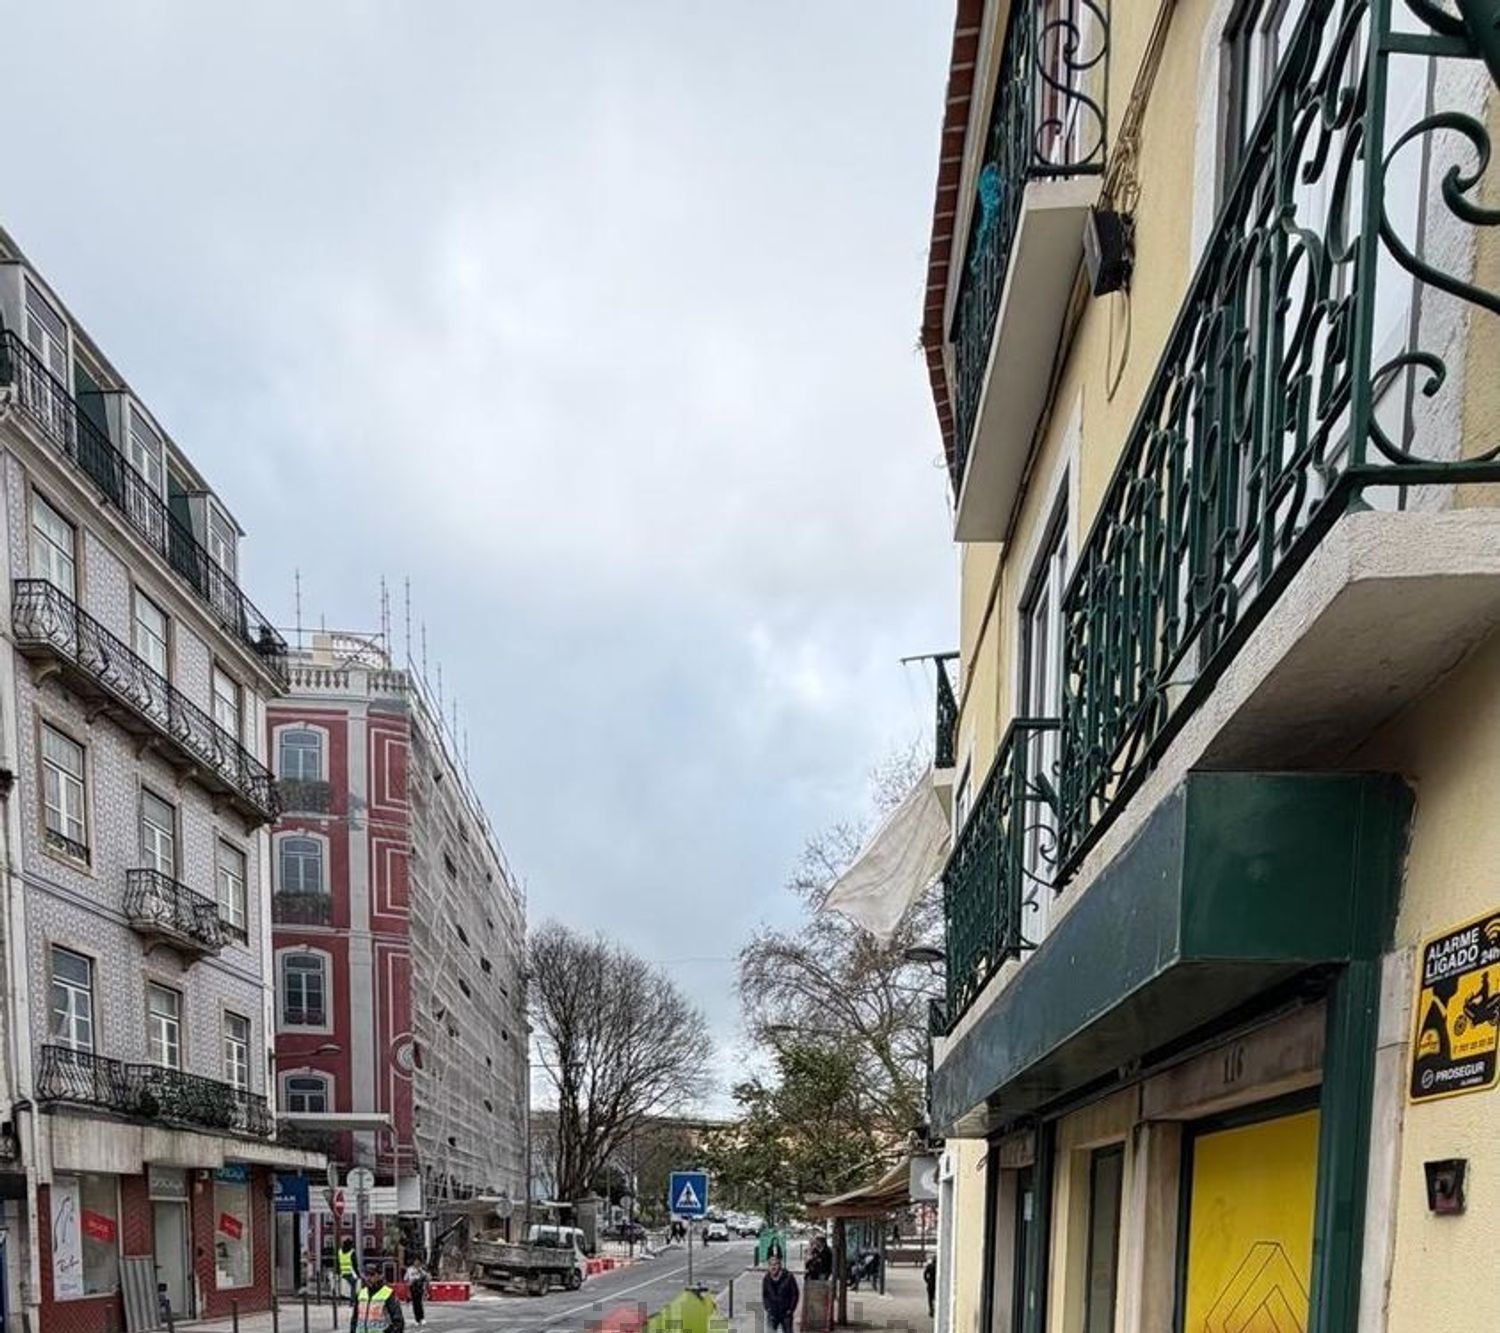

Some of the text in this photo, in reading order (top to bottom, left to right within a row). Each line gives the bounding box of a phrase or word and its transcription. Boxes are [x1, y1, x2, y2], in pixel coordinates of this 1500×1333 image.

[1427, 927, 1480, 961] ALARME
[1425, 945, 1478, 978] LIGADO
[1435, 1061, 1485, 1082] PROSEGUR
